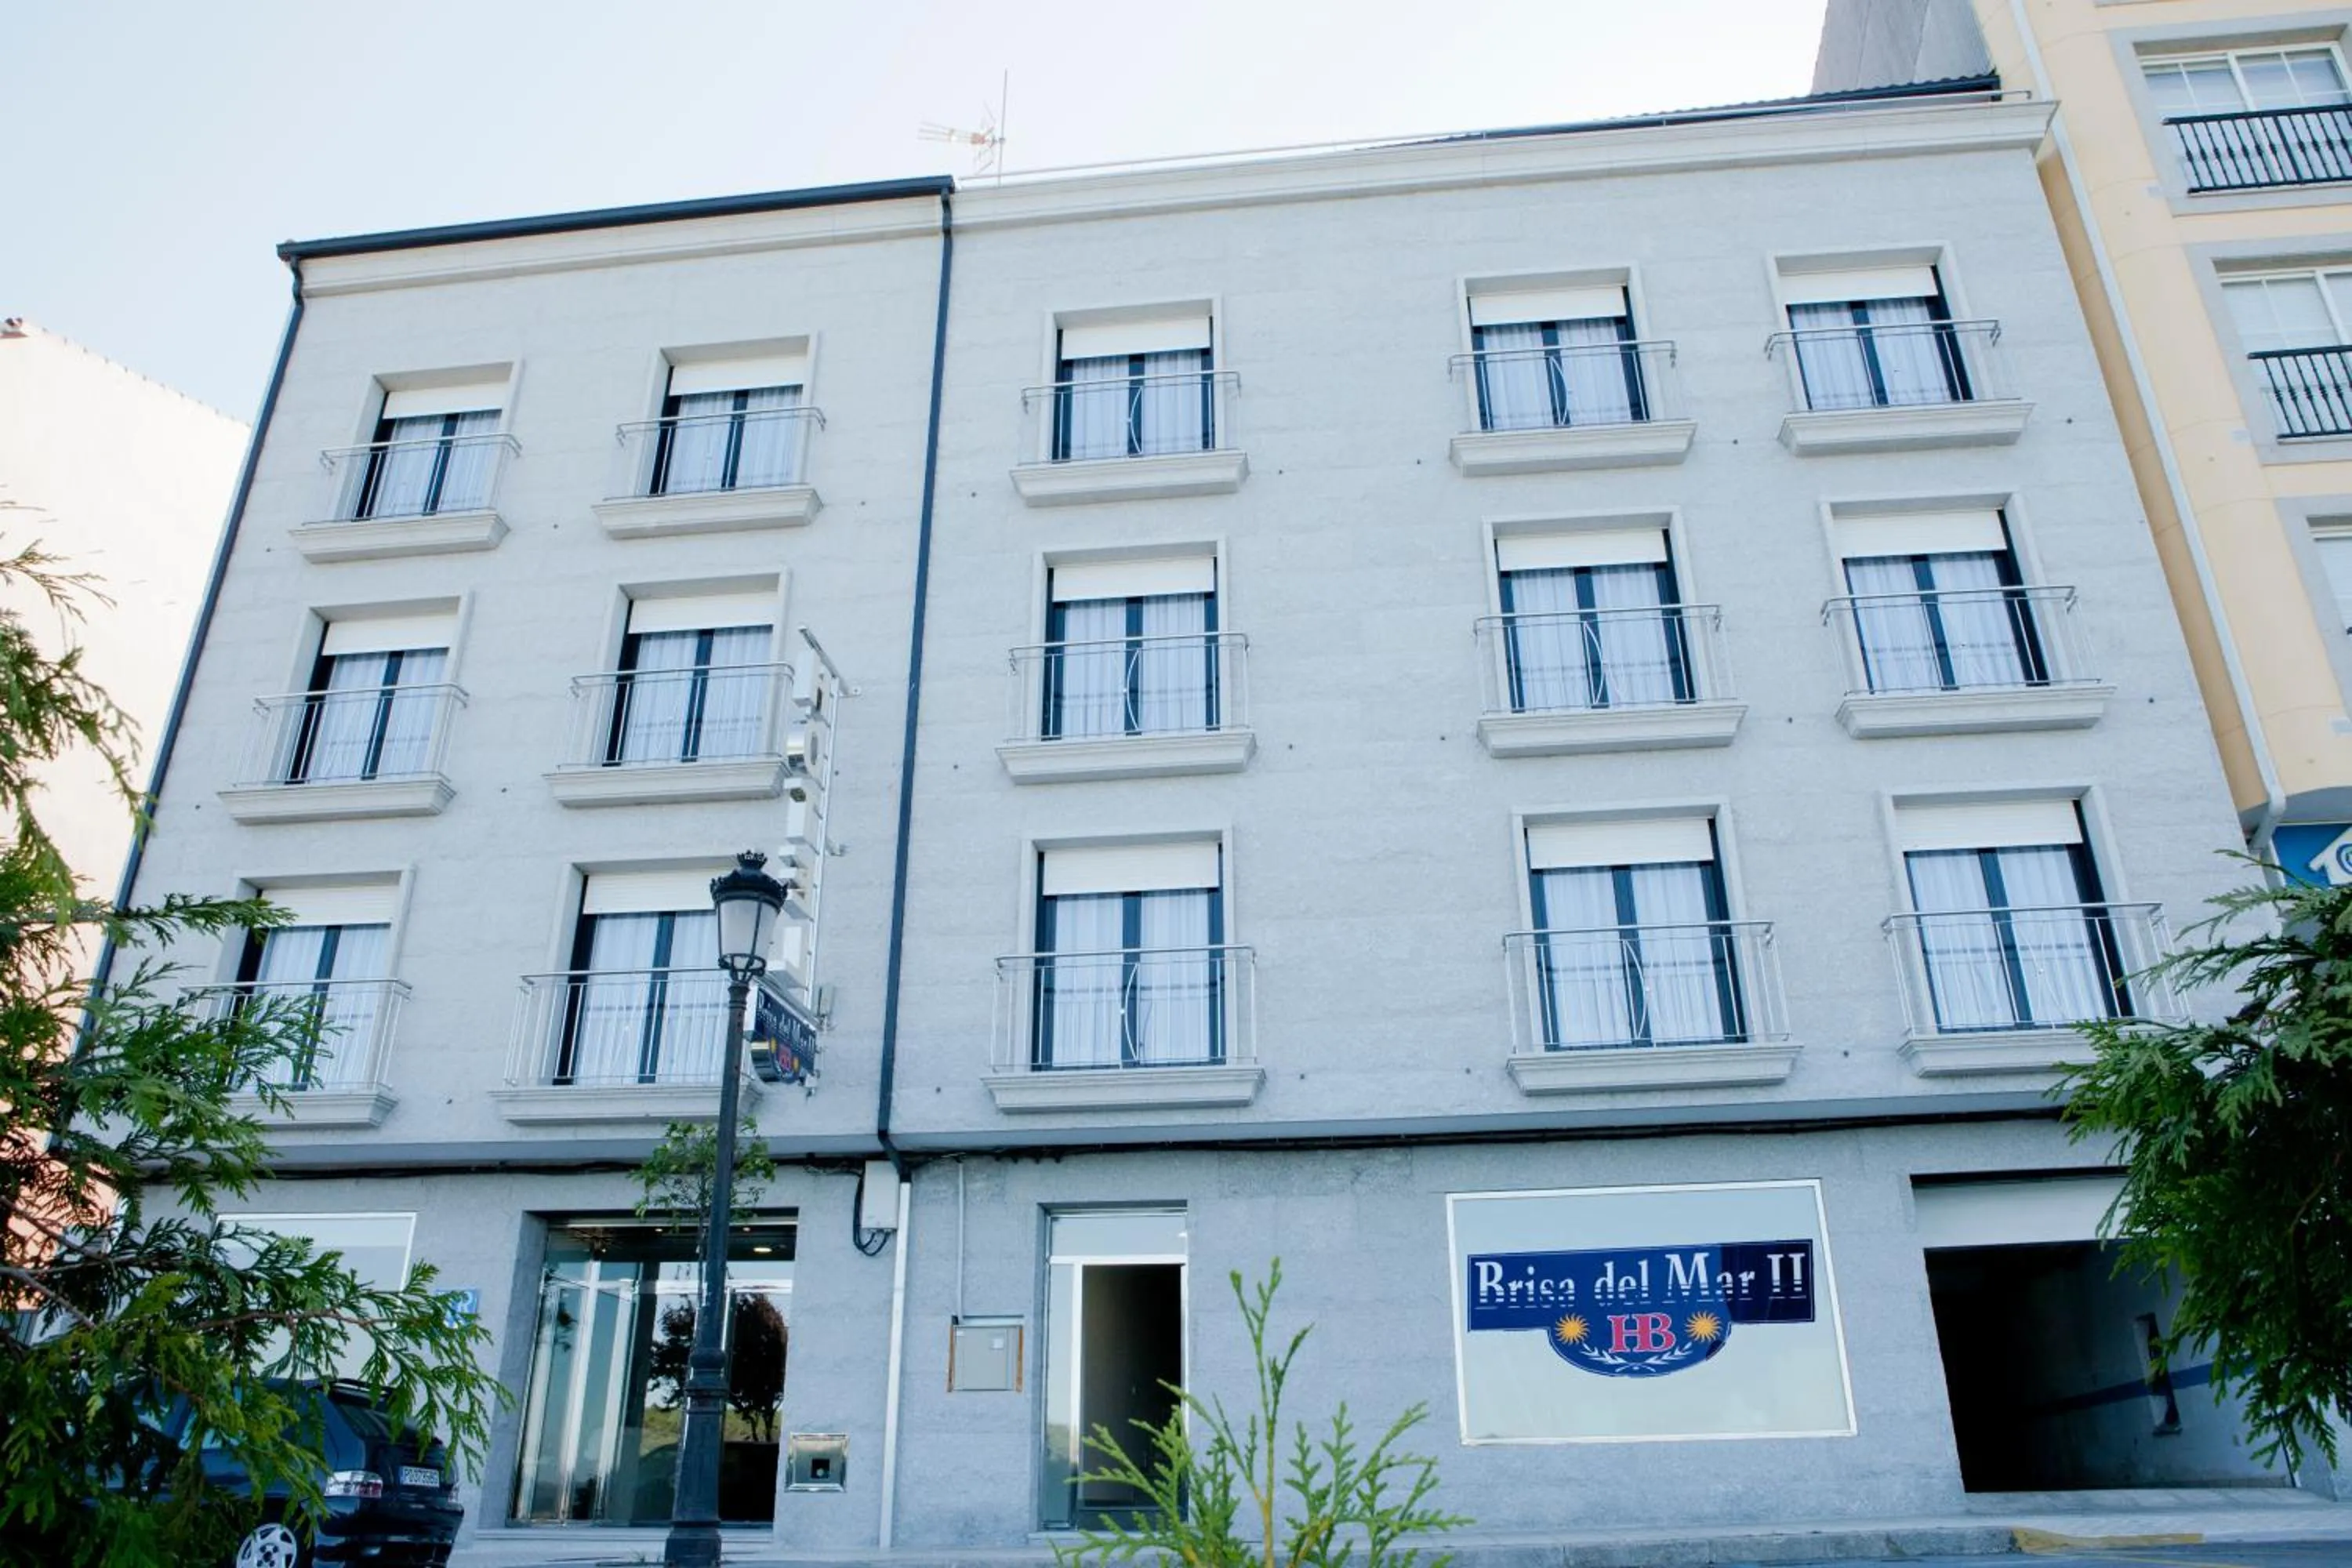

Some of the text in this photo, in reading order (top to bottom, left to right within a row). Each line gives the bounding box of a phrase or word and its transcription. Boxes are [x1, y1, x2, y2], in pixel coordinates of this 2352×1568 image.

[1474, 1252, 1807, 1309] Brisa del Mar II
[1606, 1312, 1676, 1353] HB
